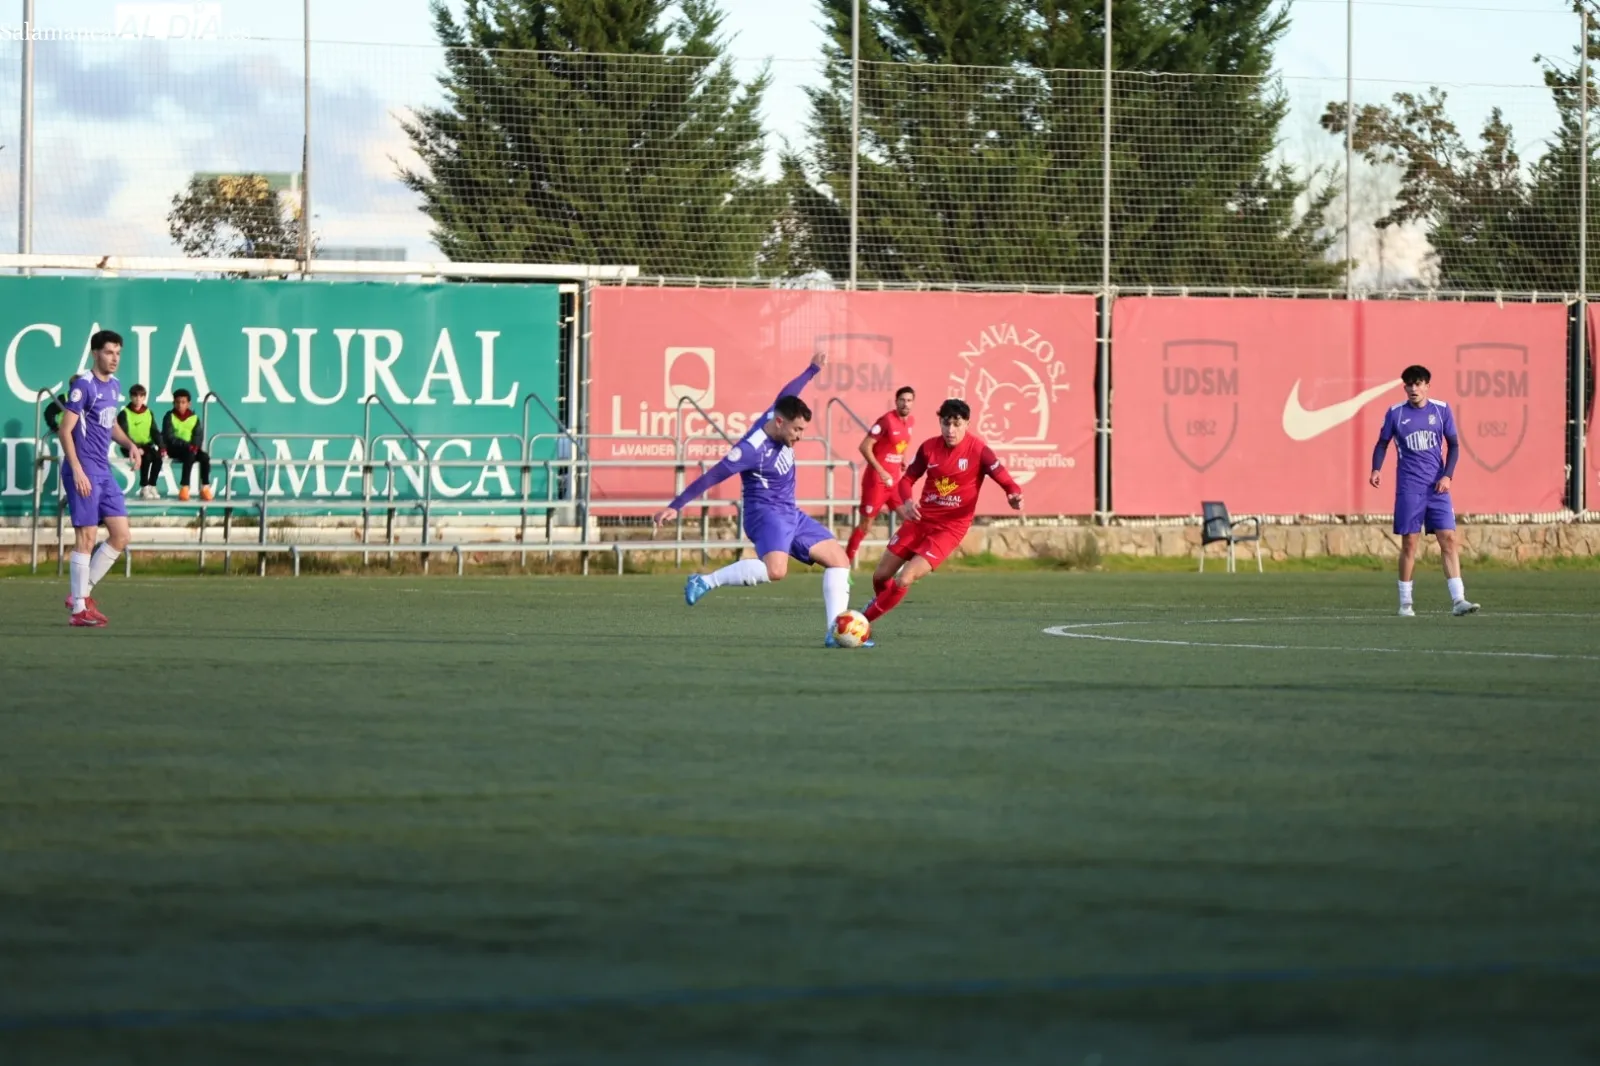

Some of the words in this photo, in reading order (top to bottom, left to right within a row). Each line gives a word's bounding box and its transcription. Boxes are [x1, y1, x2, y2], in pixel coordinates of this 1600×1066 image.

[241, 327, 519, 408] RURAL
[814, 362, 894, 392] UDSM
[1163, 366, 1239, 396] UDSM
[1455, 370, 1529, 398] UDSM
[1186, 419, 1217, 437] 1982
[1477, 420, 1508, 438] 1982
[612, 443, 683, 457] LAVANDER
[688, 443, 733, 457] PROFE
